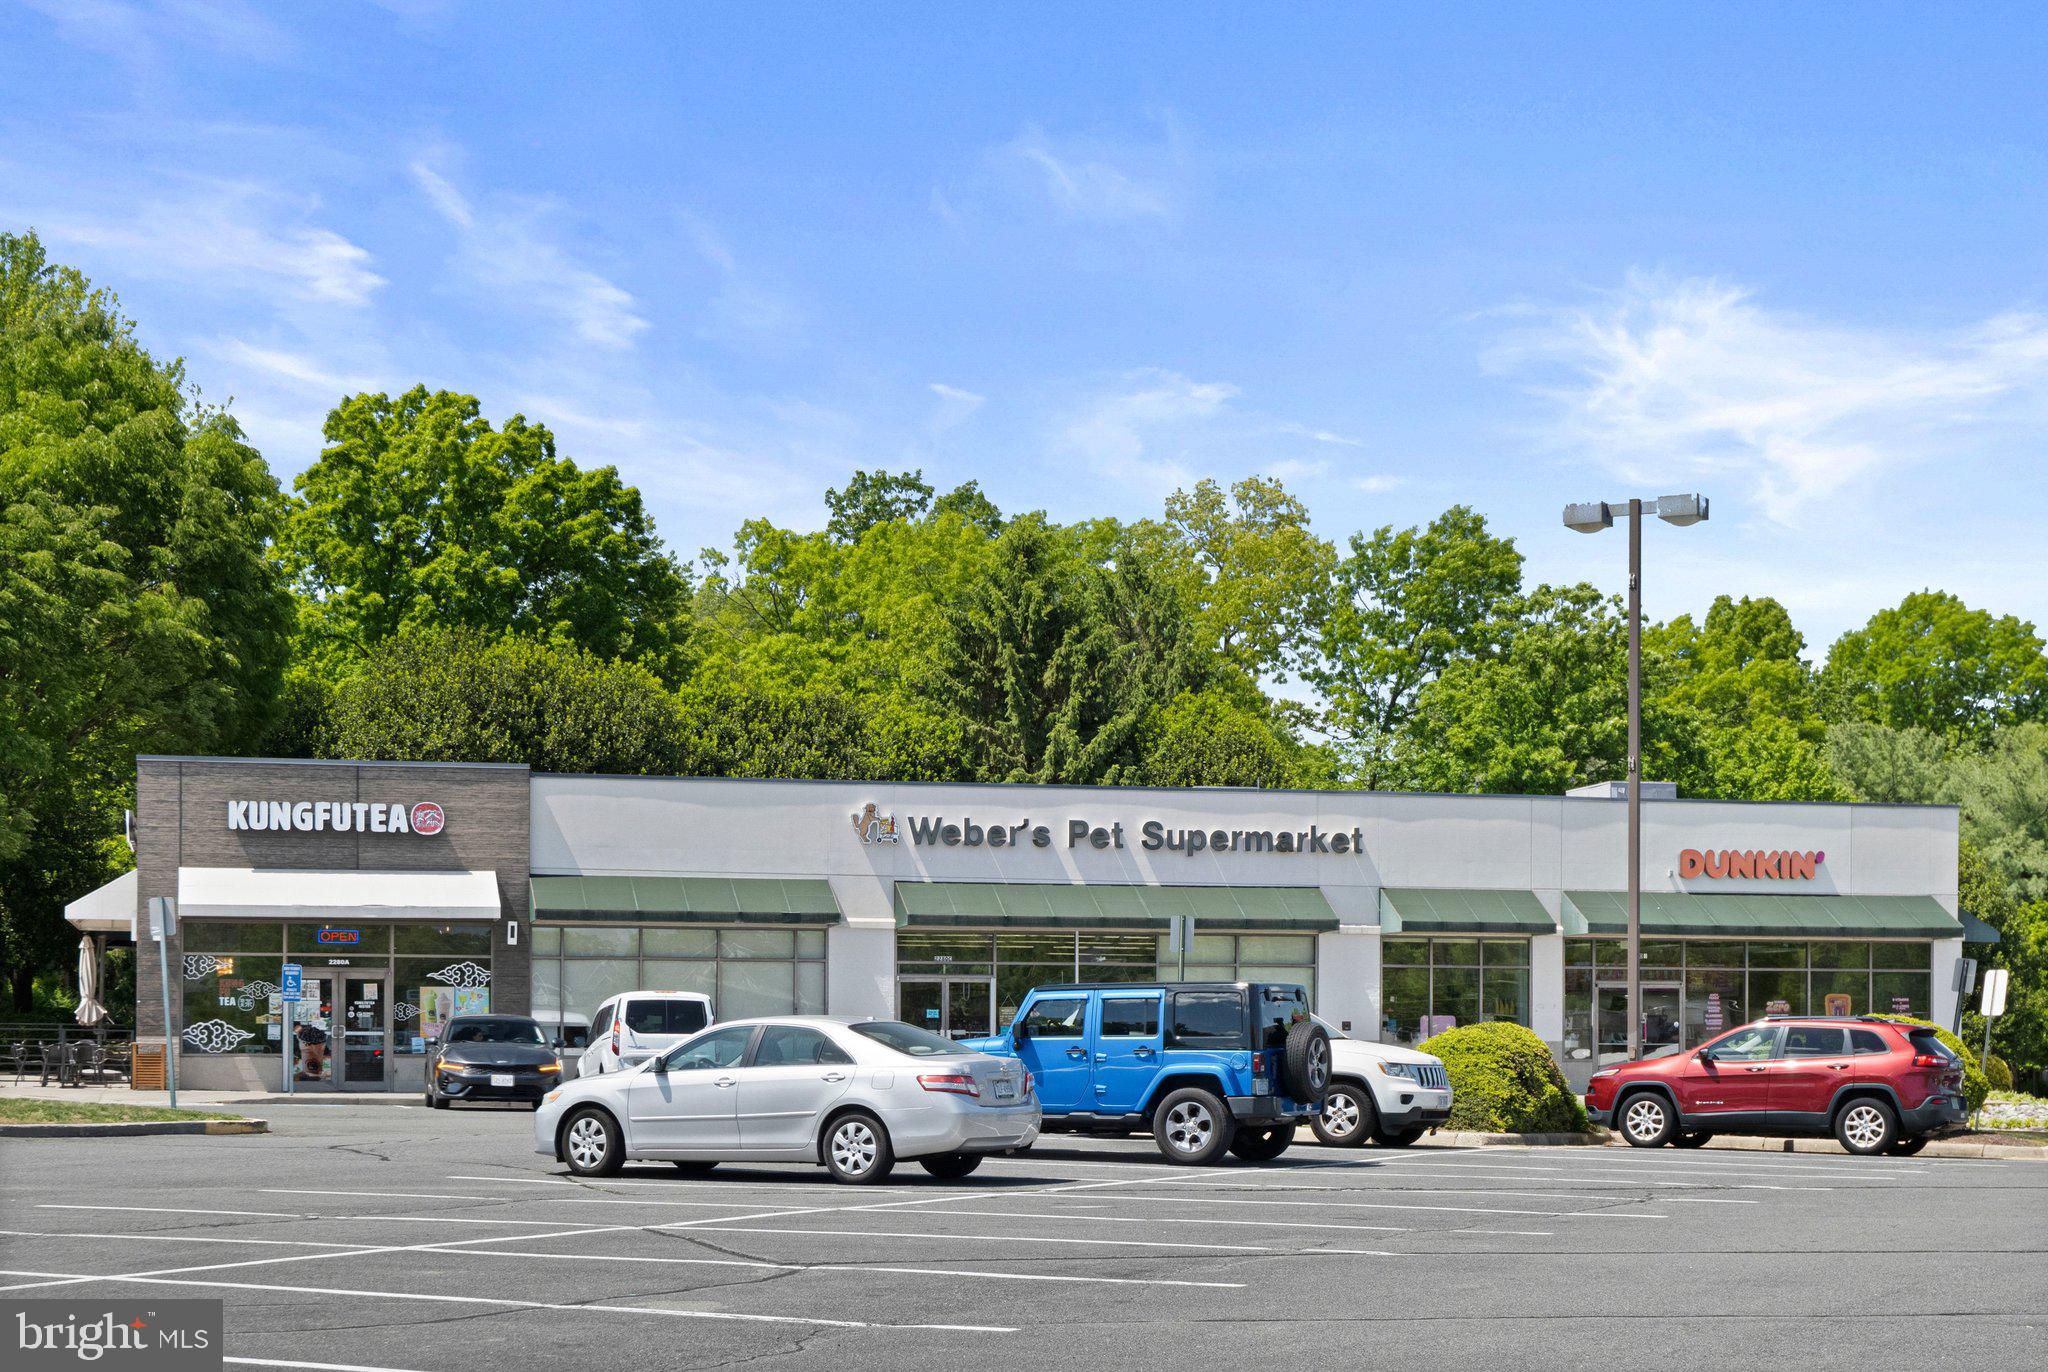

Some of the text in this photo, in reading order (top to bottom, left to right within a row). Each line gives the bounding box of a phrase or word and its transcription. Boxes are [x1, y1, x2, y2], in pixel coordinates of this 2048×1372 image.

[228, 800, 409, 833] KUNGFUTEA
[907, 816, 1363, 857] Weber's Pet Supermarket
[1679, 849, 1825, 880] DUNKIN'
[320, 931, 357, 942] OPEN
[218, 996, 237, 1006] TEA
